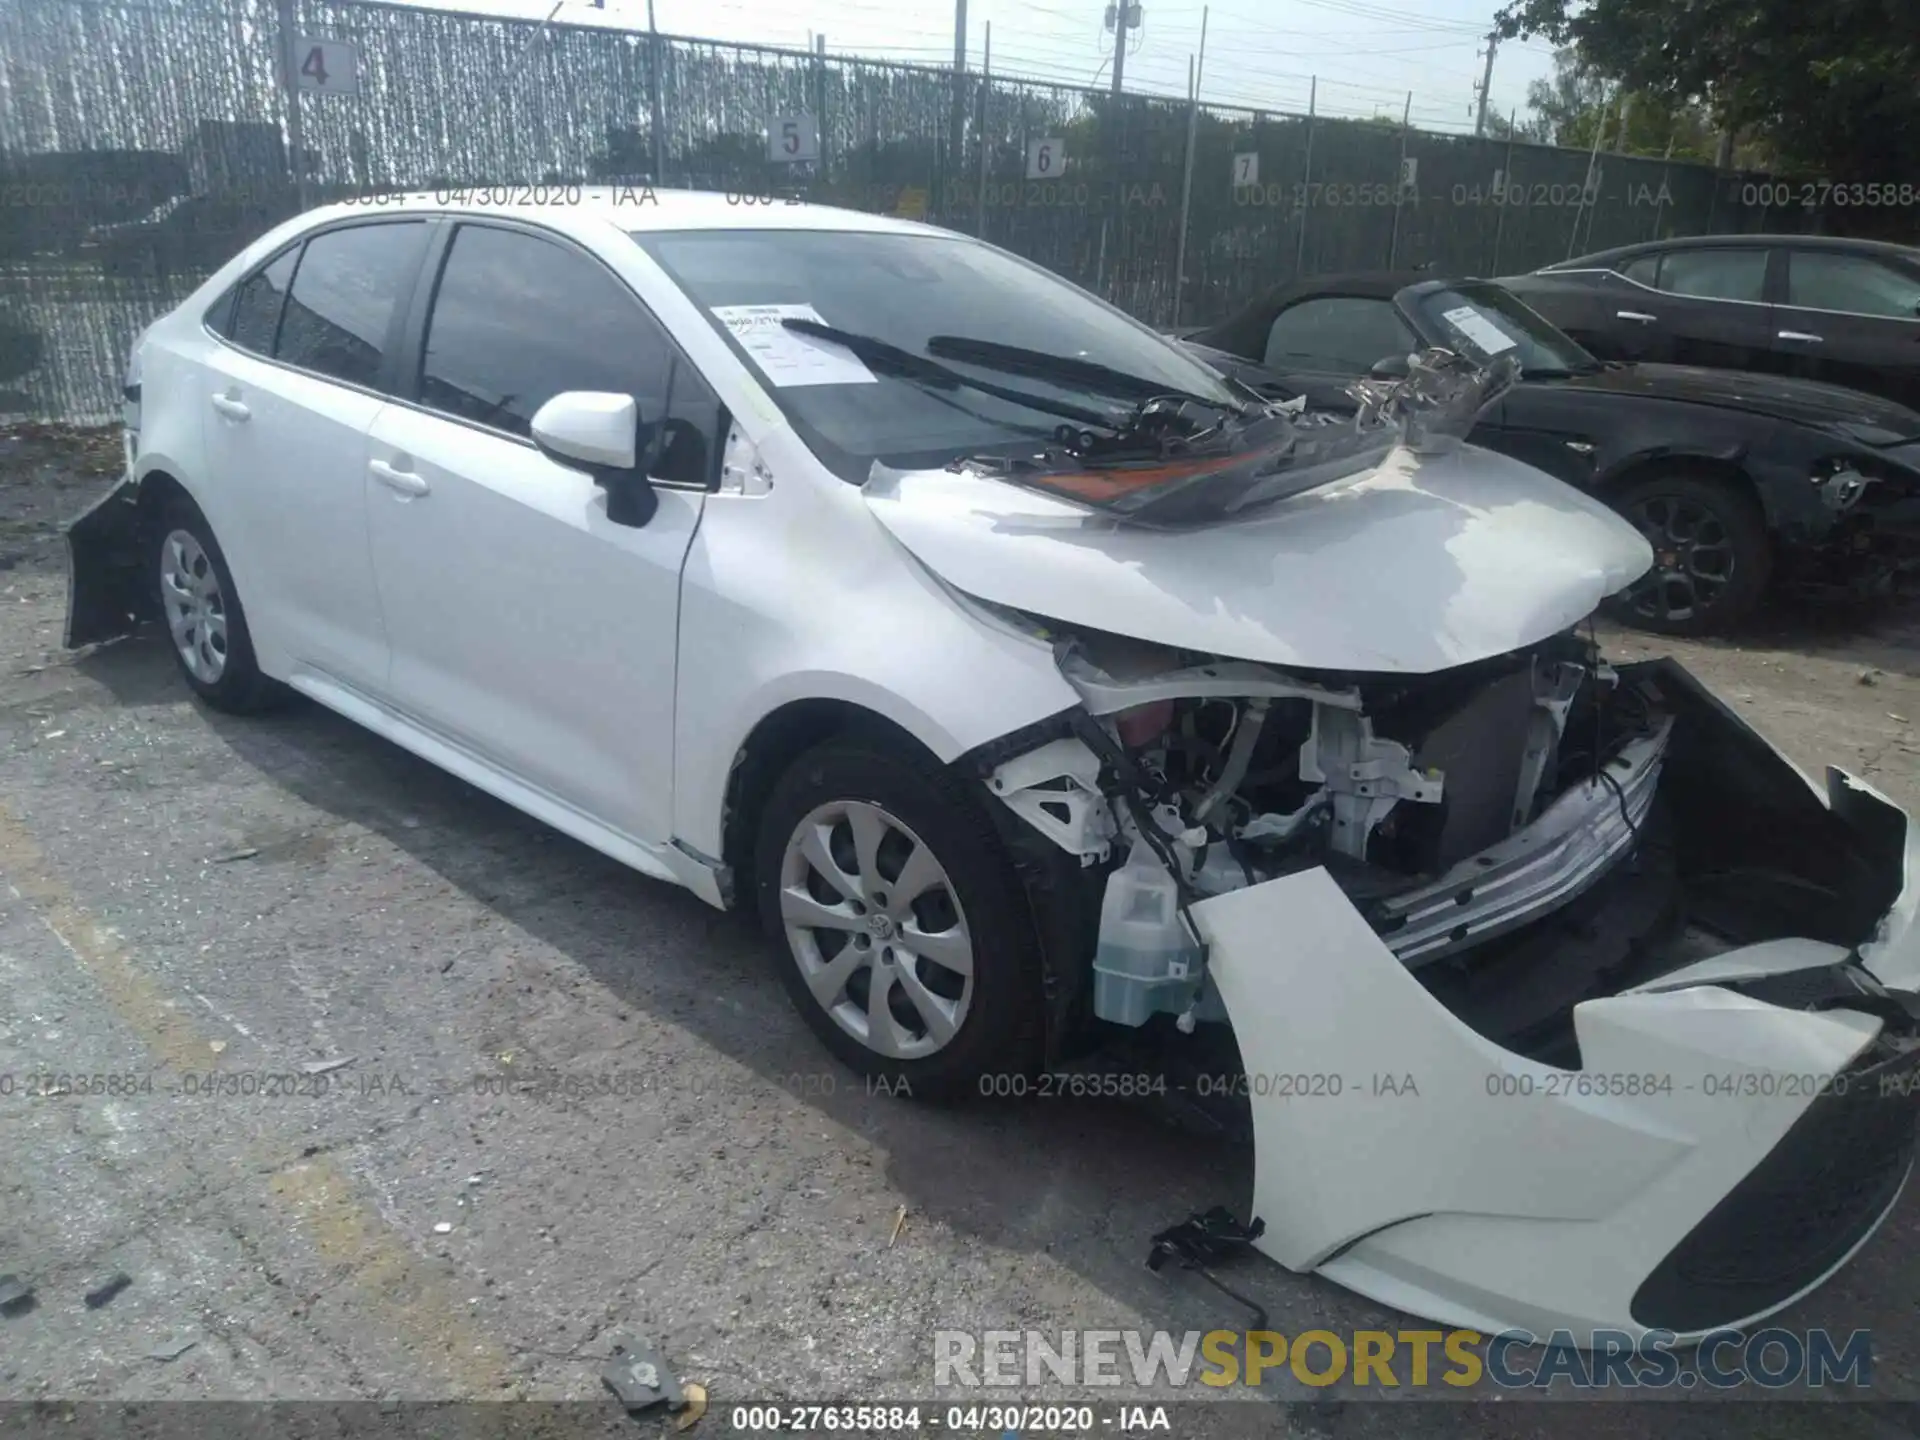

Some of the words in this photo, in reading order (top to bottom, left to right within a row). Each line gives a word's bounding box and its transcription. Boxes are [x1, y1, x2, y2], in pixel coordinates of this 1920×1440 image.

[302, 47, 330, 85] 4
[782, 122, 799, 154] 5
[1039, 145, 1051, 172] 6
[1241, 158, 1250, 180] 7
